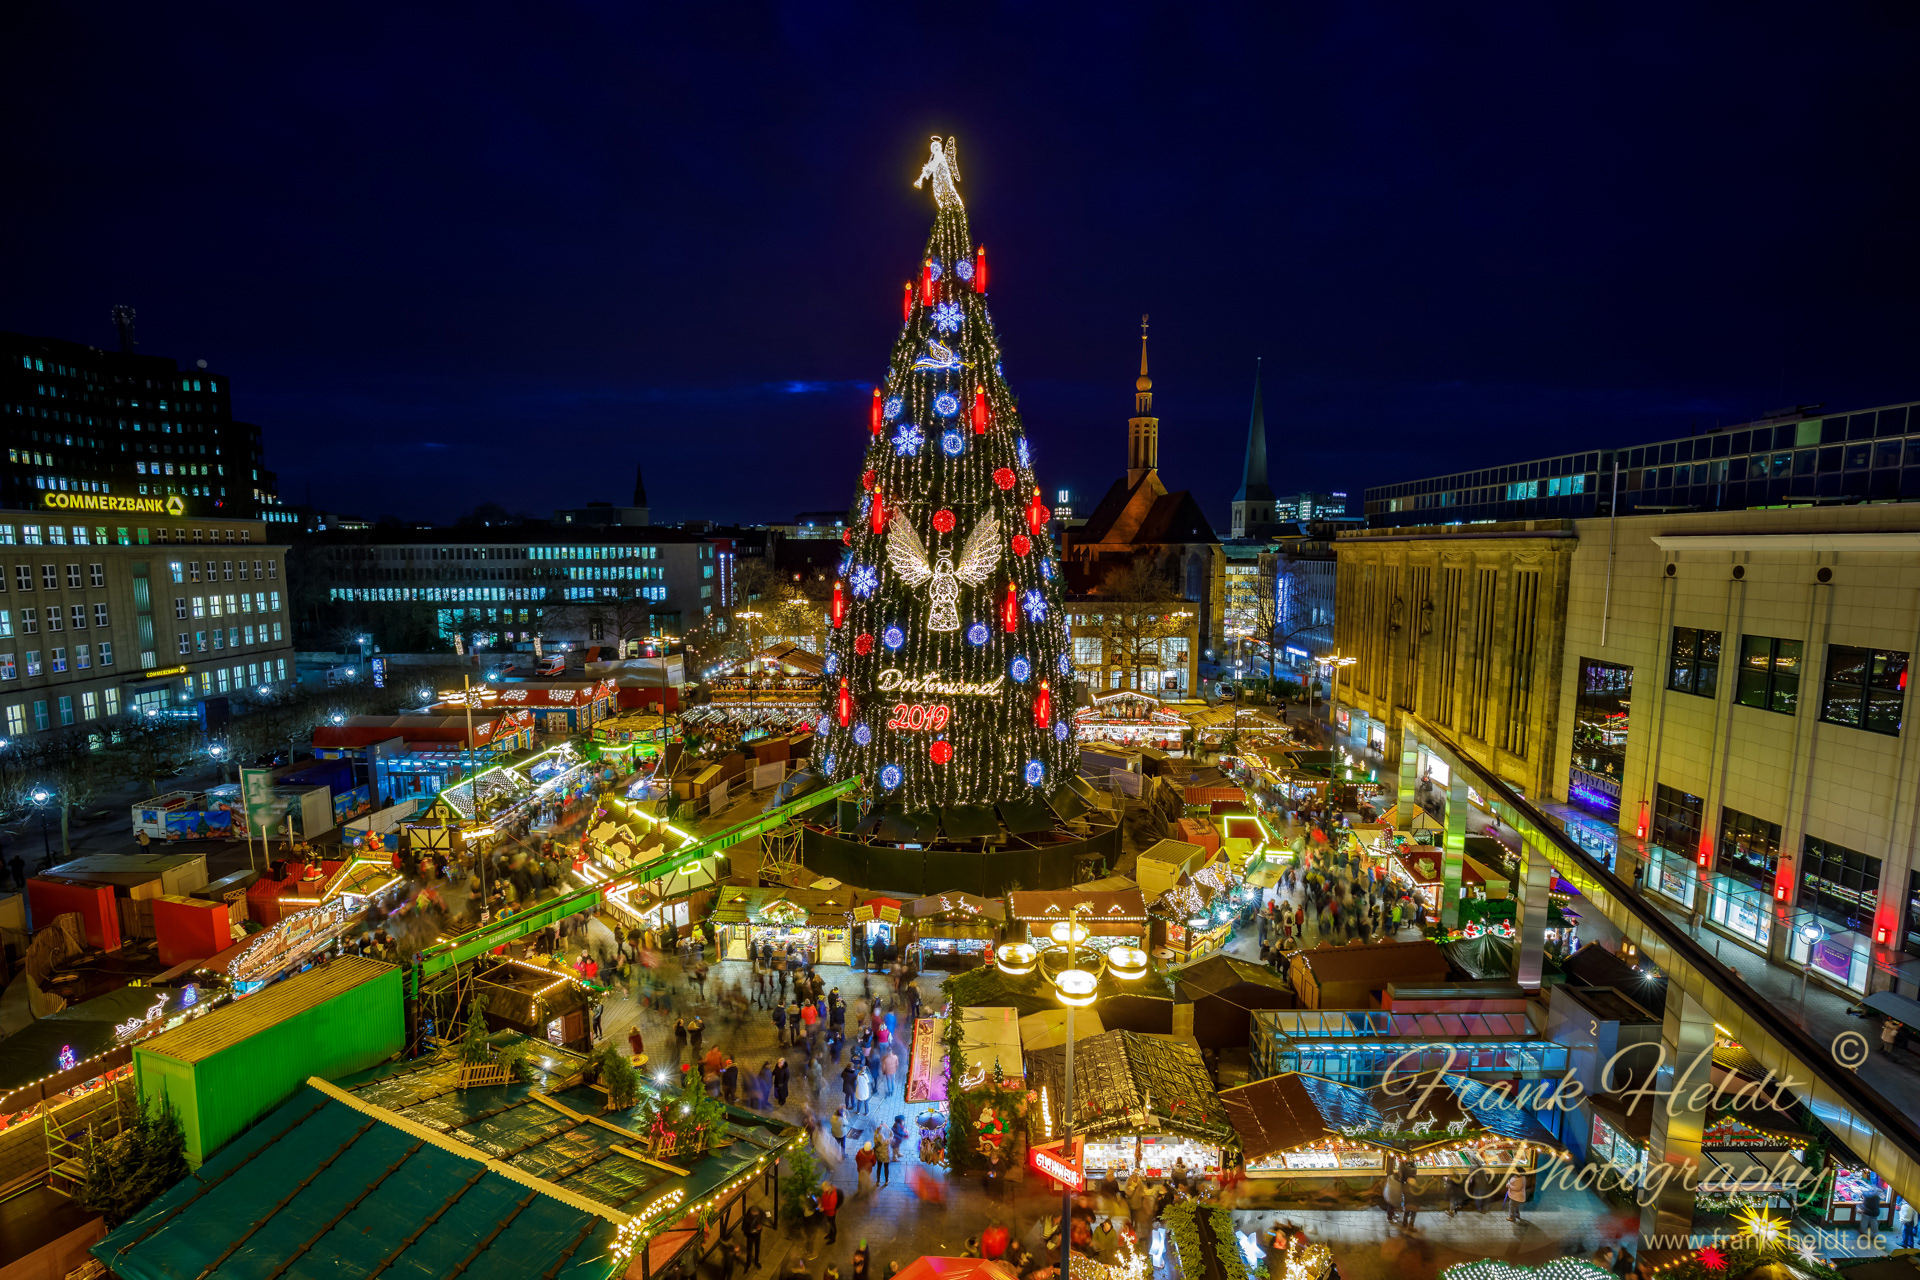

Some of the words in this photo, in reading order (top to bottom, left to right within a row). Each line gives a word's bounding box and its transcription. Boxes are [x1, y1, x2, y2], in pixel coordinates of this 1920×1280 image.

[45, 493, 164, 512] COMMERZBANK
[878, 668, 1005, 696] Dortmund
[888, 703, 950, 730] 2019
[1570, 767, 1621, 797] KARSTADT
[1589, 1019, 1598, 1037] 2
